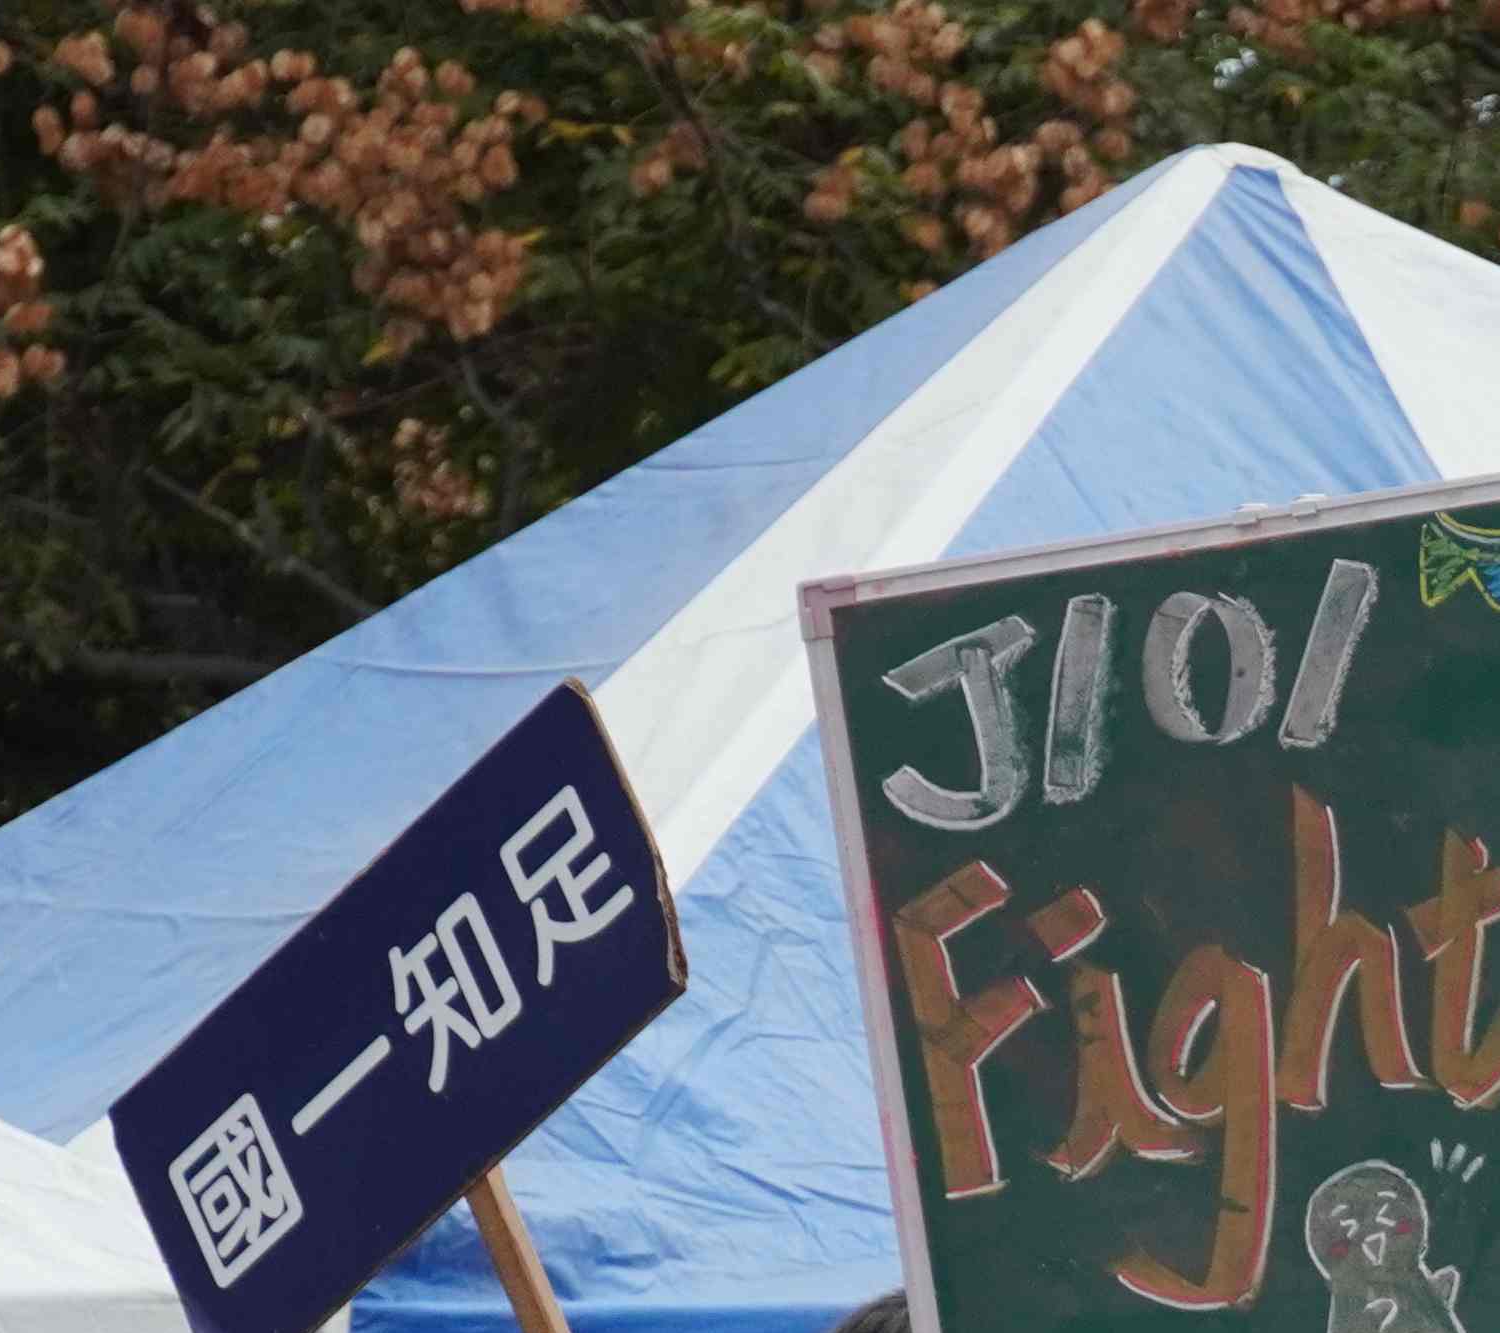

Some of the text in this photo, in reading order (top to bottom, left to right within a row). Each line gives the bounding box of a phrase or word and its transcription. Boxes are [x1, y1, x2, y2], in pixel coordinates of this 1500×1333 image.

[876, 555, 1384, 834] J101
[165, 780, 638, 1292] 國一知足
